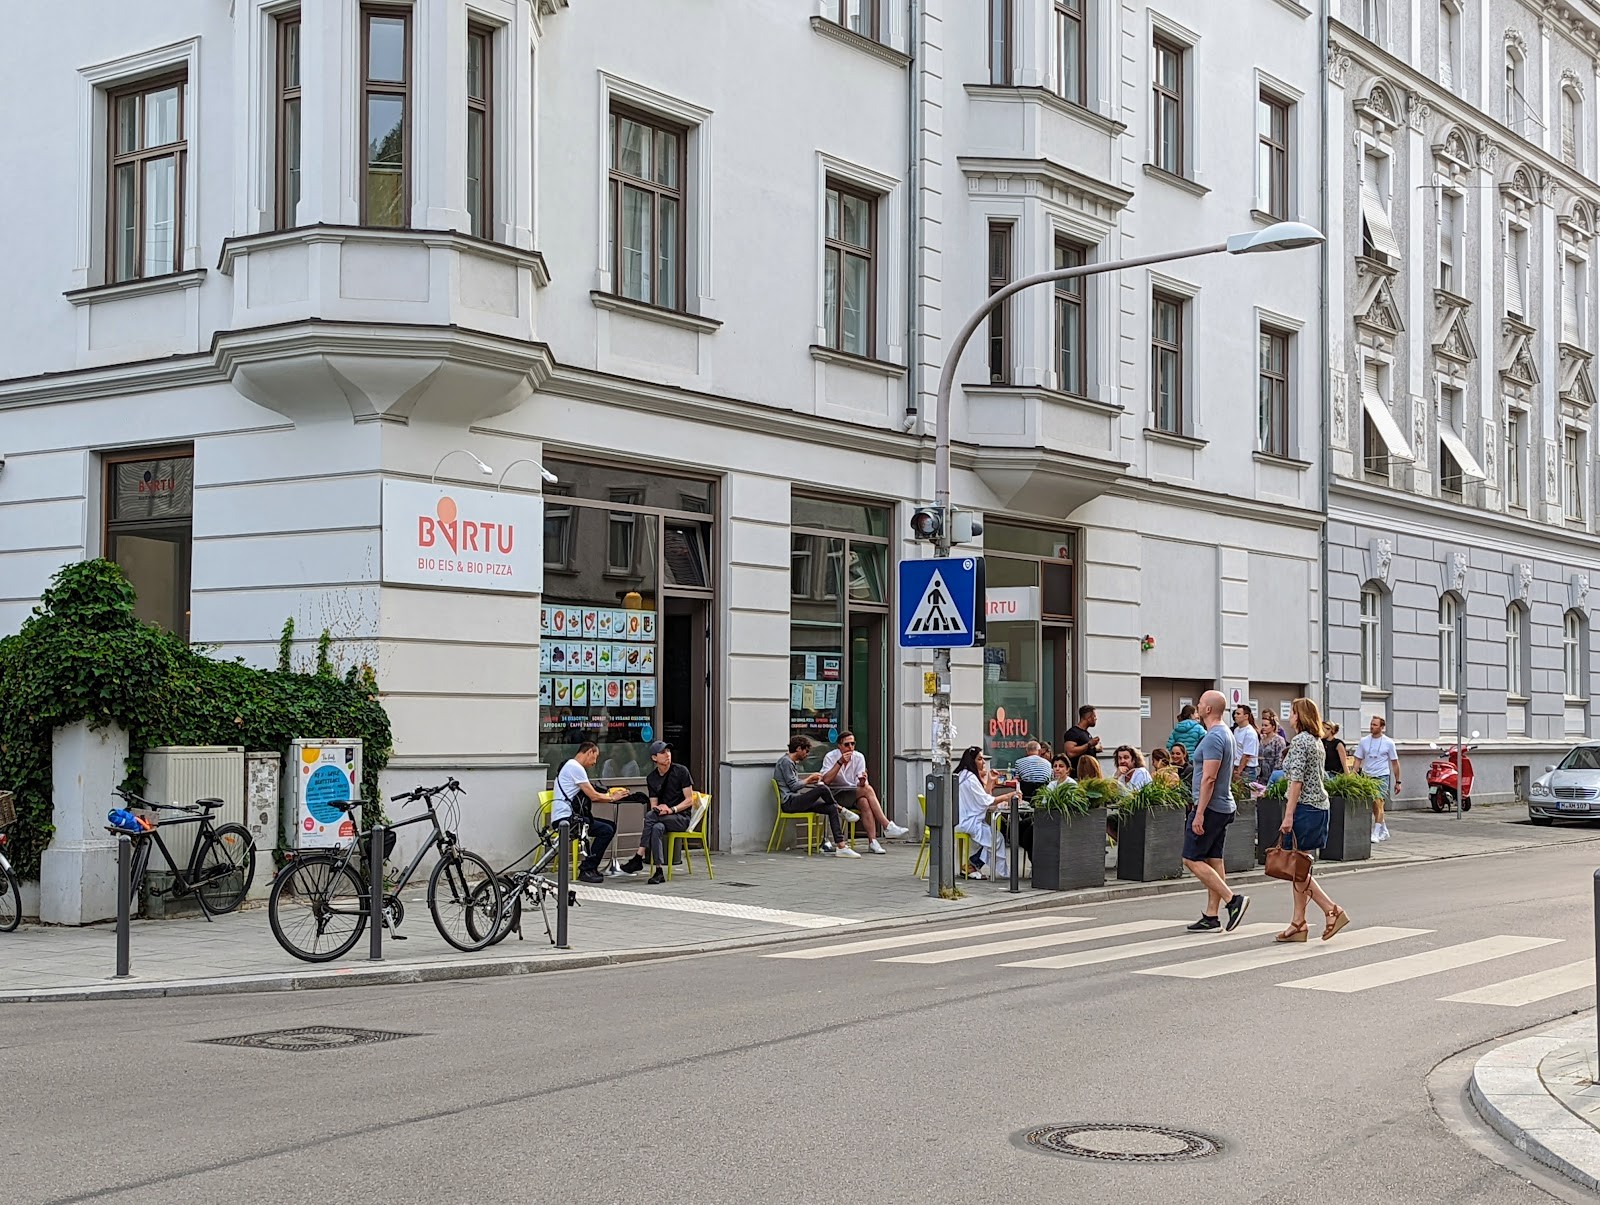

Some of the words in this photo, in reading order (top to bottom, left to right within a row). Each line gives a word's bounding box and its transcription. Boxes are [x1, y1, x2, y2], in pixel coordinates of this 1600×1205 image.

[418, 557, 435, 570] BIO
[438, 559, 454, 572] EIS
[456, 561, 464, 573] &
[467, 562, 483, 574] BIO
[486, 563, 513, 576] PIZZA
